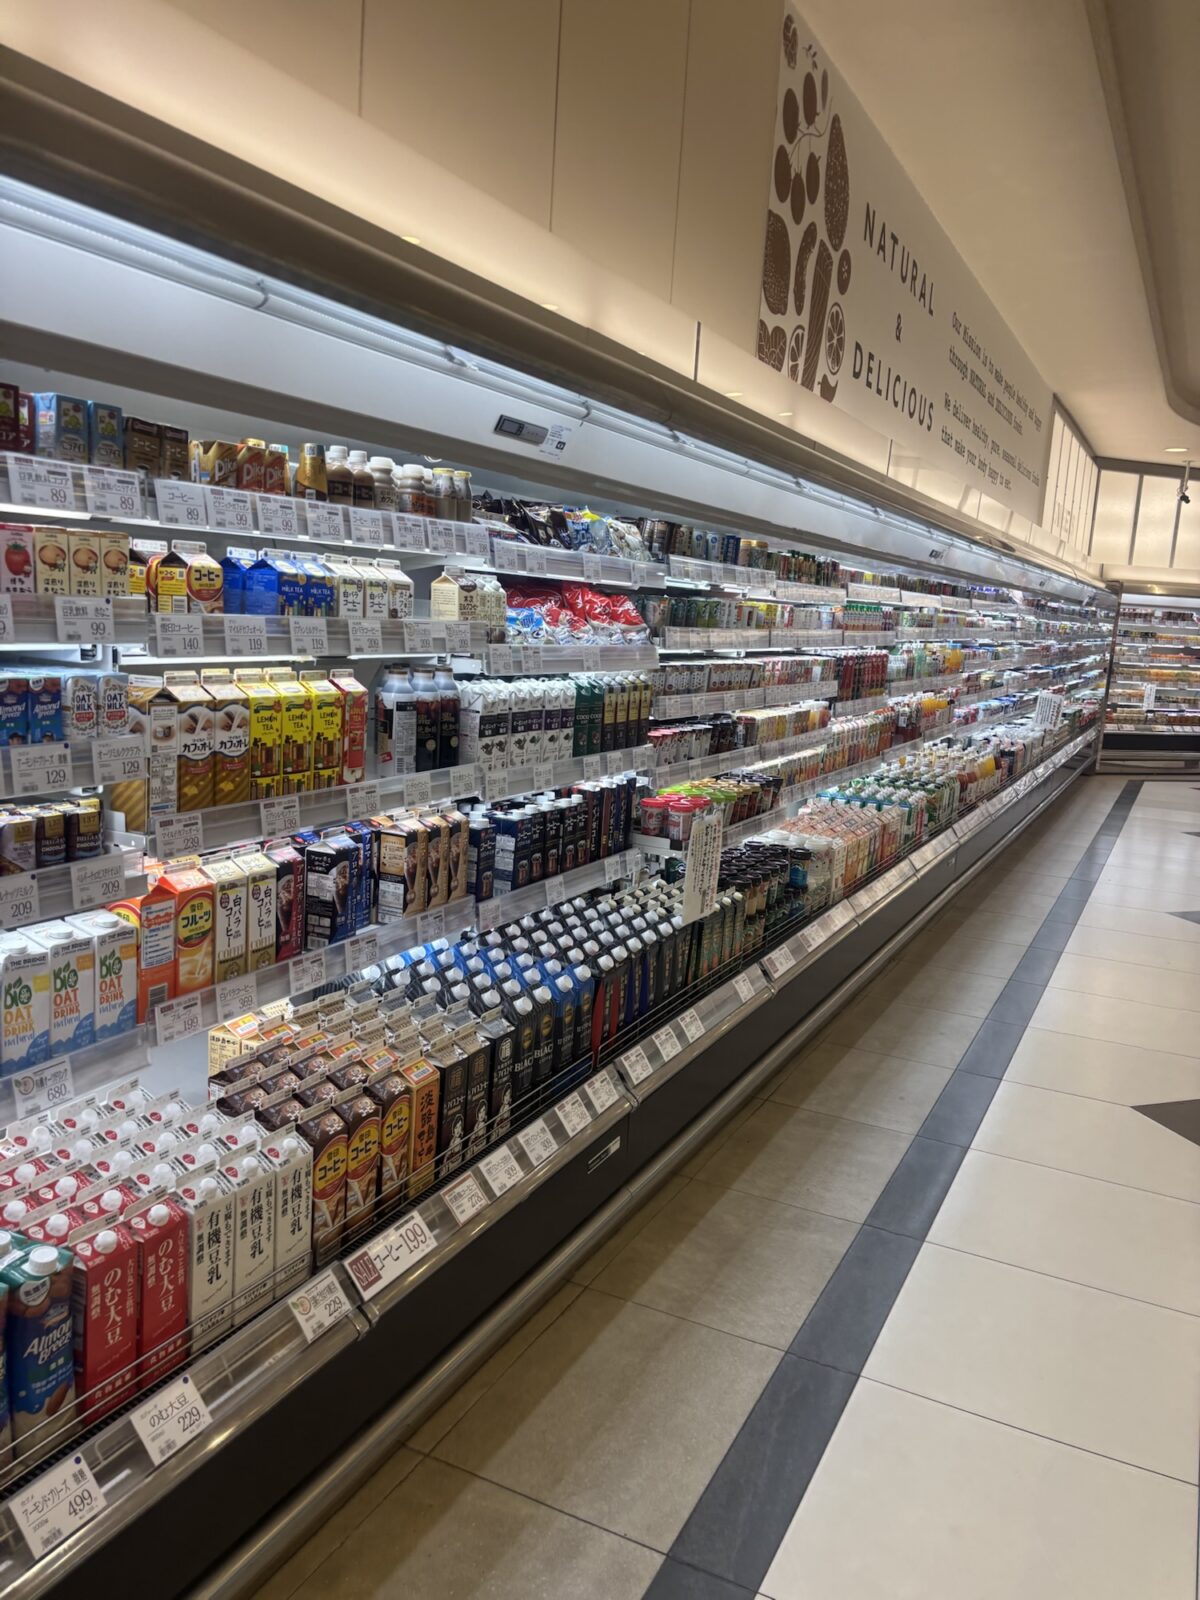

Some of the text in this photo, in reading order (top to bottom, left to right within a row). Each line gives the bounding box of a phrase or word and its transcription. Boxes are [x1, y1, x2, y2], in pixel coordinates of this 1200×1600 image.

[863, 201, 935, 317] NATURAL
[895, 313, 903, 343] &
[949, 345, 968, 382] through
[852, 340, 935, 432] DELICIOUS
[944, 392, 951, 412] We
[952, 400, 972, 430] deliver
[132, 438, 158, 451] コーヒー
[941, 425, 953, 448] that
[955, 438, 965, 458] make
[966, 448, 976, 466] your
[50, 488, 66, 504] 89
[120, 496, 134, 510] 89
[168, 492, 195, 502] コーヒー
[186, 508, 199, 521] 89
[235, 513, 248, 526] 99
[281, 519, 293, 532] 99
[194, 569, 220, 582] コーヒー
[343, 599, 361, 608] コーヒー
[369, 600, 386, 608] コーヒー
[90, 622, 106, 636] 99
[183, 636, 199, 650] 140
[249, 638, 262, 650] 119
[312, 638, 324, 650] 119
[367, 638, 379, 649] 209
[76, 693, 92, 703] OAT
[106, 692, 124, 702] OAT
[33, 701, 60, 714] Almond
[76, 702, 92, 712] MILK
[107, 701, 124, 710] MILK
[182, 740, 214, 754] カフェオーレ
[122, 761, 140, 775] 129
[46, 770, 66, 784] 129
[83, 815, 96, 824] 137
[283, 818, 297, 830] 139
[183, 836, 200, 850] 239
[101, 880, 120, 896] 209
[10, 901, 32, 918] 209
[233, 895, 242, 924] 白バラ
[264, 886, 273, 918] 白バラ
[181, 911, 211, 929] フルーツ
[226, 907, 234, 948] コーヒー
[117, 929, 135, 938] BRIDGE
[70, 941, 91, 950] BRIDGE
[23, 955, 46, 965] BRIDGE
[100, 975, 123, 992] OAT
[54, 987, 80, 1007] OAT
[100, 990, 124, 1004] DRINK
[220, 984, 254, 1000] 白バラコーヒー
[239, 995, 253, 1009] 369
[4, 1005, 33, 1024] OAT
[54, 1004, 80, 1020] DRINK
[170, 1010, 193, 1024] フルーツ
[4, 1023, 34, 1037] DRINK
[183, 1016, 199, 1032] 199
[534, 1044, 553, 1059] BLAC
[514, 1056, 534, 1073] BLAC
[47, 1083, 68, 1102] 680
[386, 1117, 408, 1138] コーヒー
[351, 1140, 377, 1161] コーヒー
[319, 1158, 346, 1180] コーヒー
[291, 1168, 303, 1236] 有機豆乳
[250, 1187, 264, 1259] 有機豆乳
[399, 1222, 427, 1254] 199
[208, 1210, 221, 1286] 有機豆乳
[374, 1244, 403, 1272] コーヒー
[158, 1238, 175, 1313] のむ大豆
[353, 1256, 378, 1287] SALE
[104, 1268, 124, 1346] のむ大豆
[324, 1296, 343, 1317] 229
[23, 1319, 72, 1358] Almon
[149, 1392, 189, 1429] のむ大豆
[177, 1406, 201, 1434] 229
[68, 1488, 94, 1518] 499
